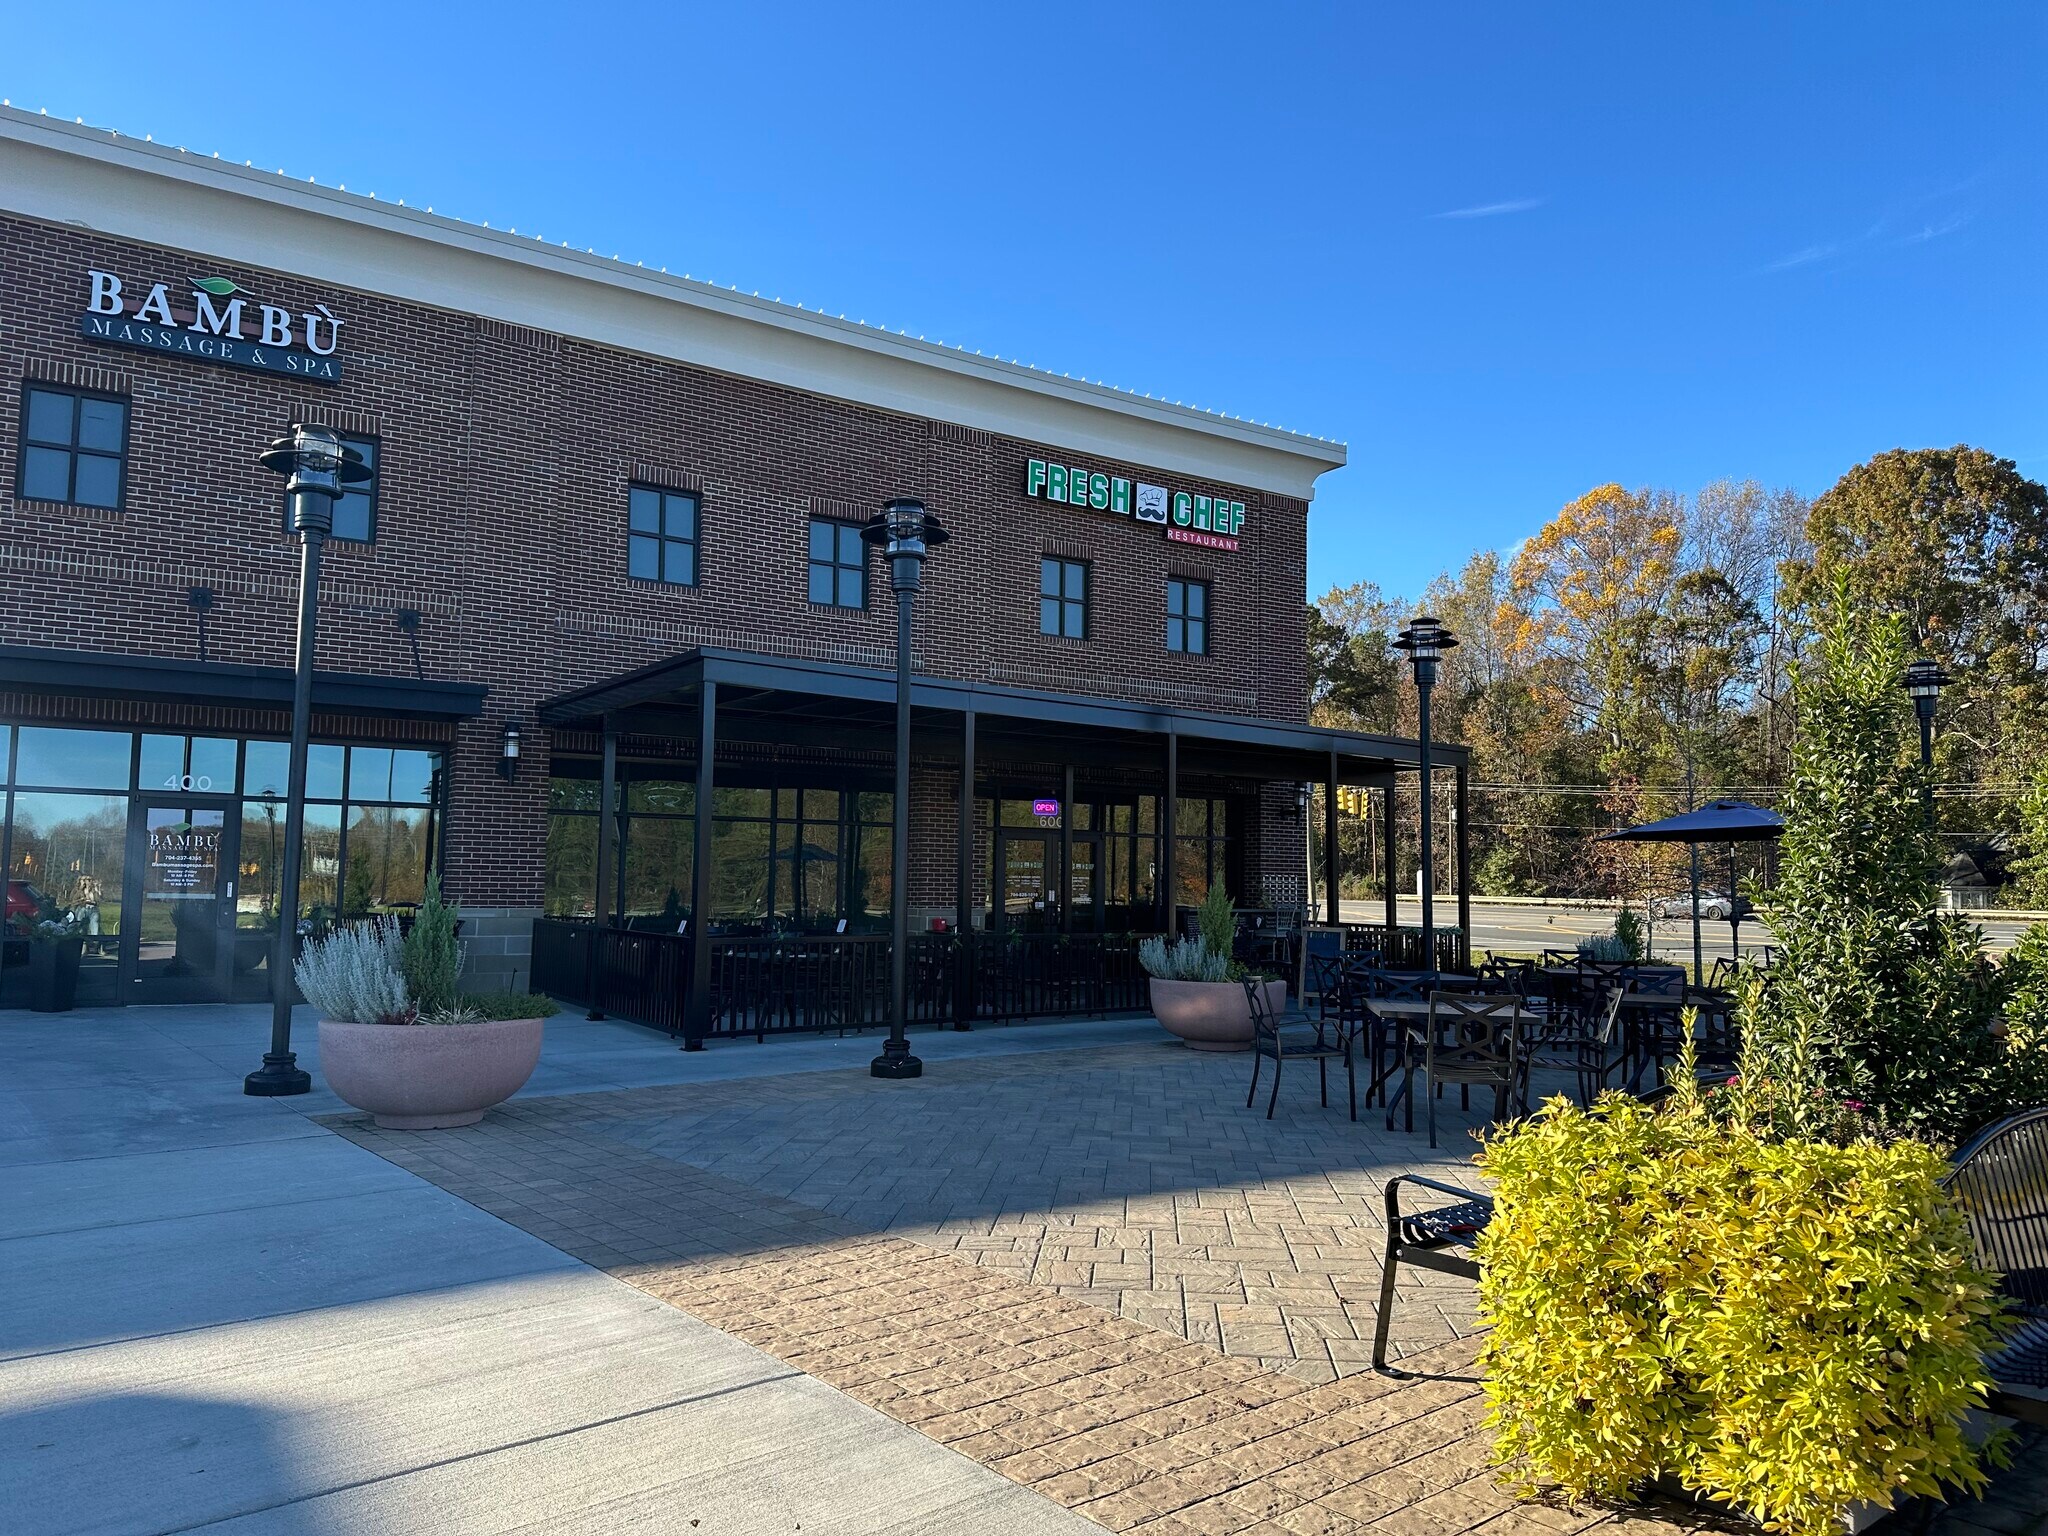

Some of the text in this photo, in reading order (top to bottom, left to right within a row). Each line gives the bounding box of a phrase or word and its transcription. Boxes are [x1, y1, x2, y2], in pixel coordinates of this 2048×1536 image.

[87, 270, 345, 355] BAMBÙ
[91, 317, 333, 377] MASSAGE & SPA
[1027, 458, 1246, 536] FRESH CHEF
[1167, 528, 1239, 551] RESTAURANT
[163, 774, 212, 791] 400
[1035, 803, 1055, 812] OPEN
[1039, 815, 1062, 828] 600
